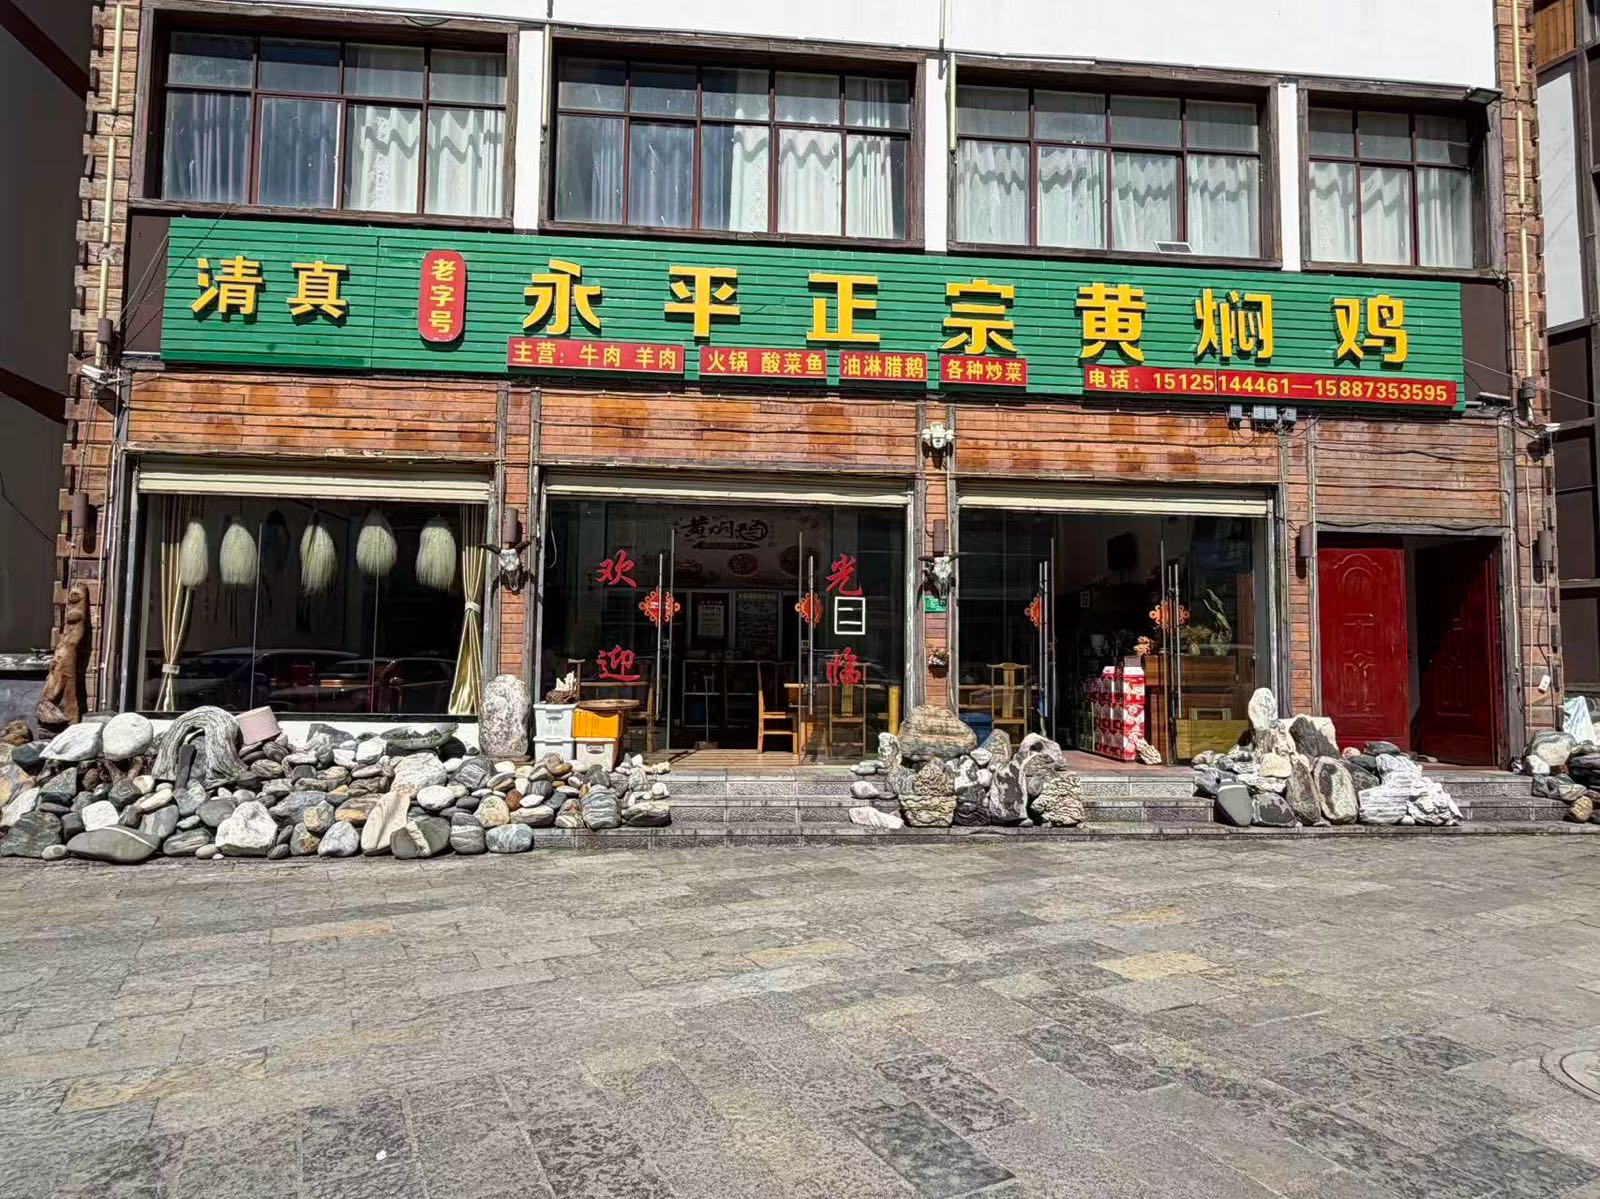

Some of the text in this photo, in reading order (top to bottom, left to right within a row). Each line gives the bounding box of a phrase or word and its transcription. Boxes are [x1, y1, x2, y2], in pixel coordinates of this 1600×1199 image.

[191, 255, 347, 319] 清真
[427, 258, 456, 334] 老字号
[522, 259, 1409, 364] 永平正宗黄焖鸡
[707, 350, 824, 375] 火锅 酸菜鱼
[843, 354, 924, 379] 油淋腊鹅
[947, 358, 1023, 383] 各种炒菜
[595, 549, 640, 681] 欢迎
